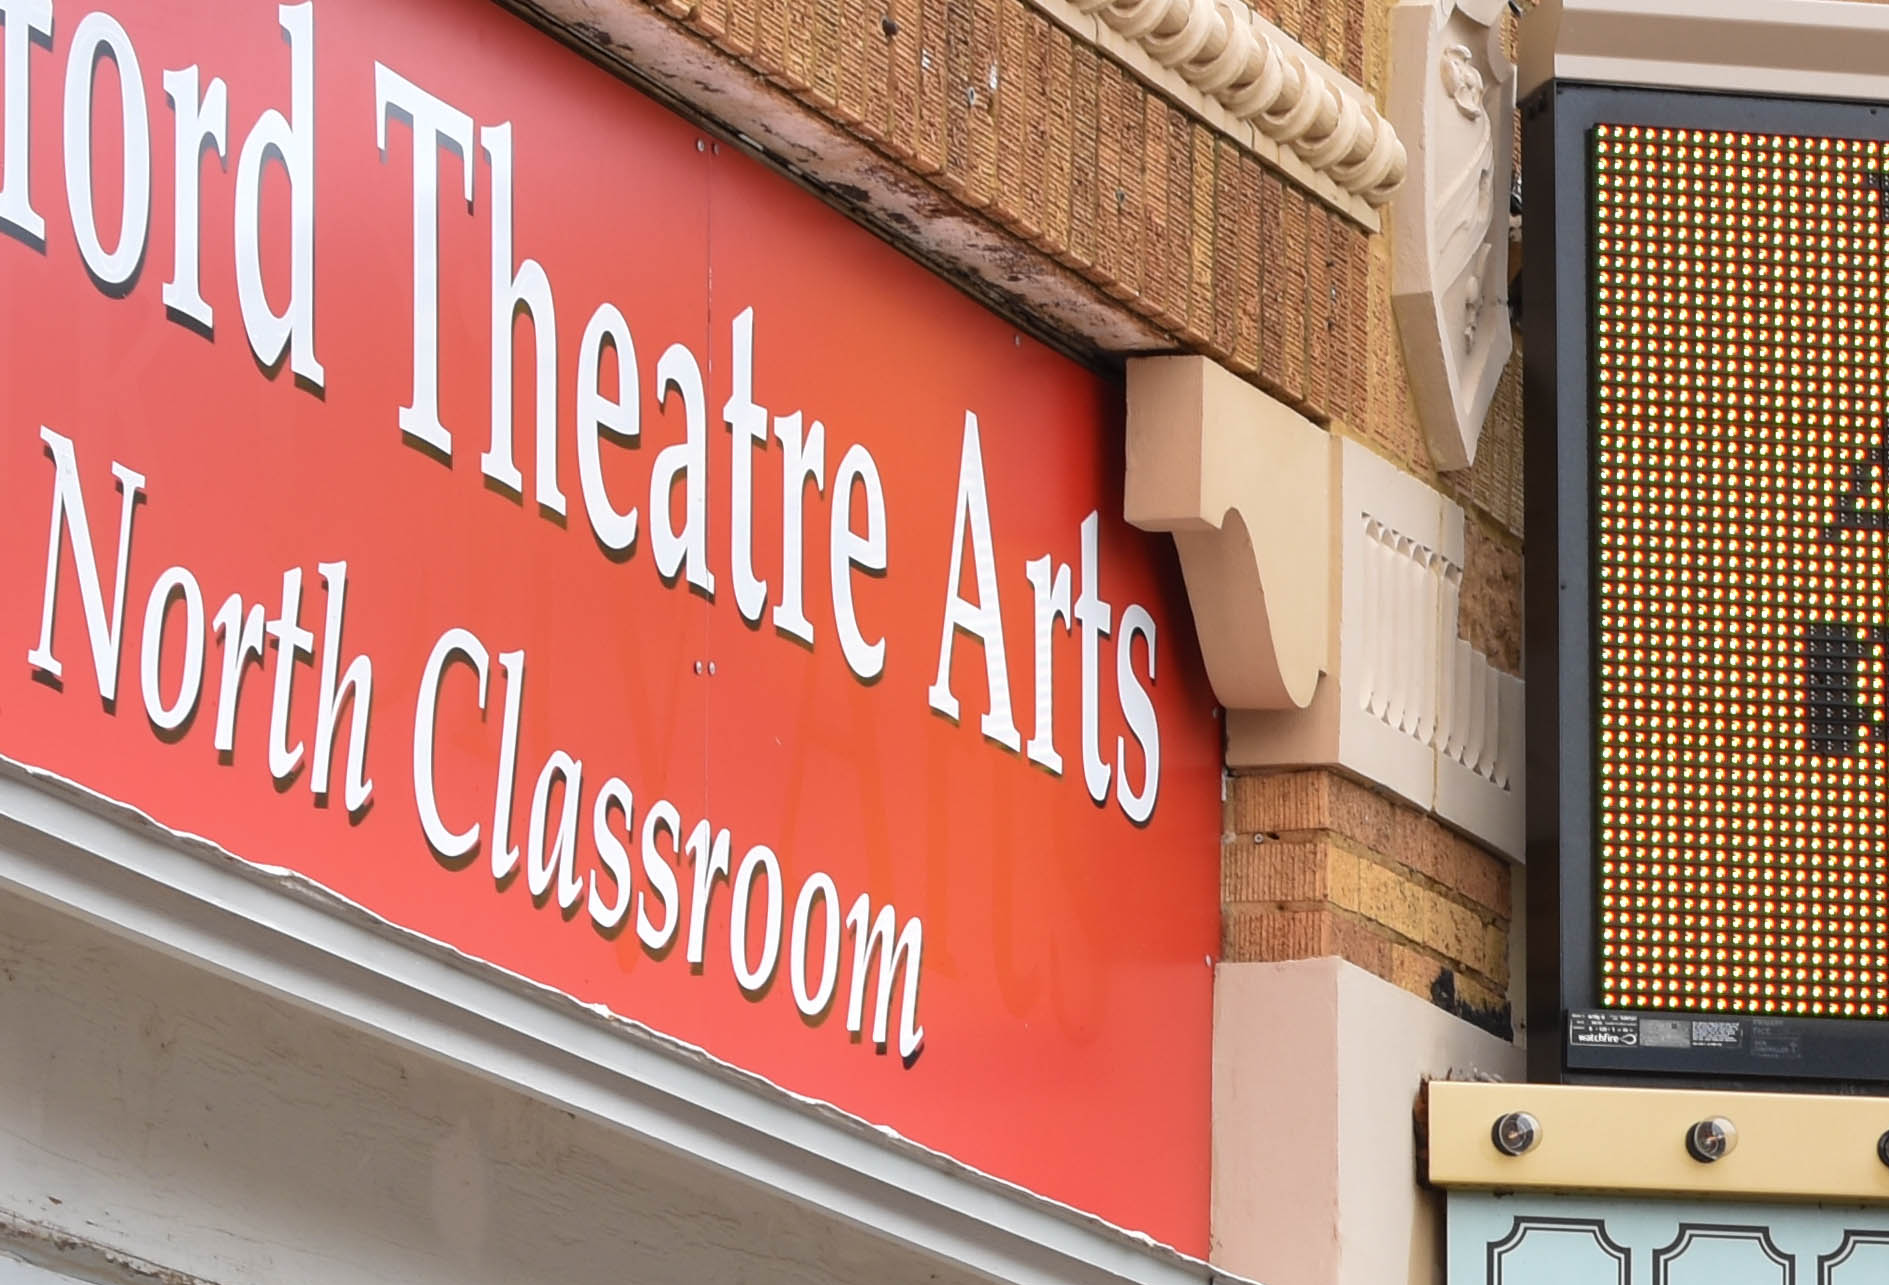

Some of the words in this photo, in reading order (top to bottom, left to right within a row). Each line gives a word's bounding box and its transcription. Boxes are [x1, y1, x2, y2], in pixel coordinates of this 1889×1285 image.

[27, 424, 376, 813] North
[412, 626, 925, 1060] Classroom
[375, 60, 888, 682] Theatre
[929, 409, 1161, 824] Arts
